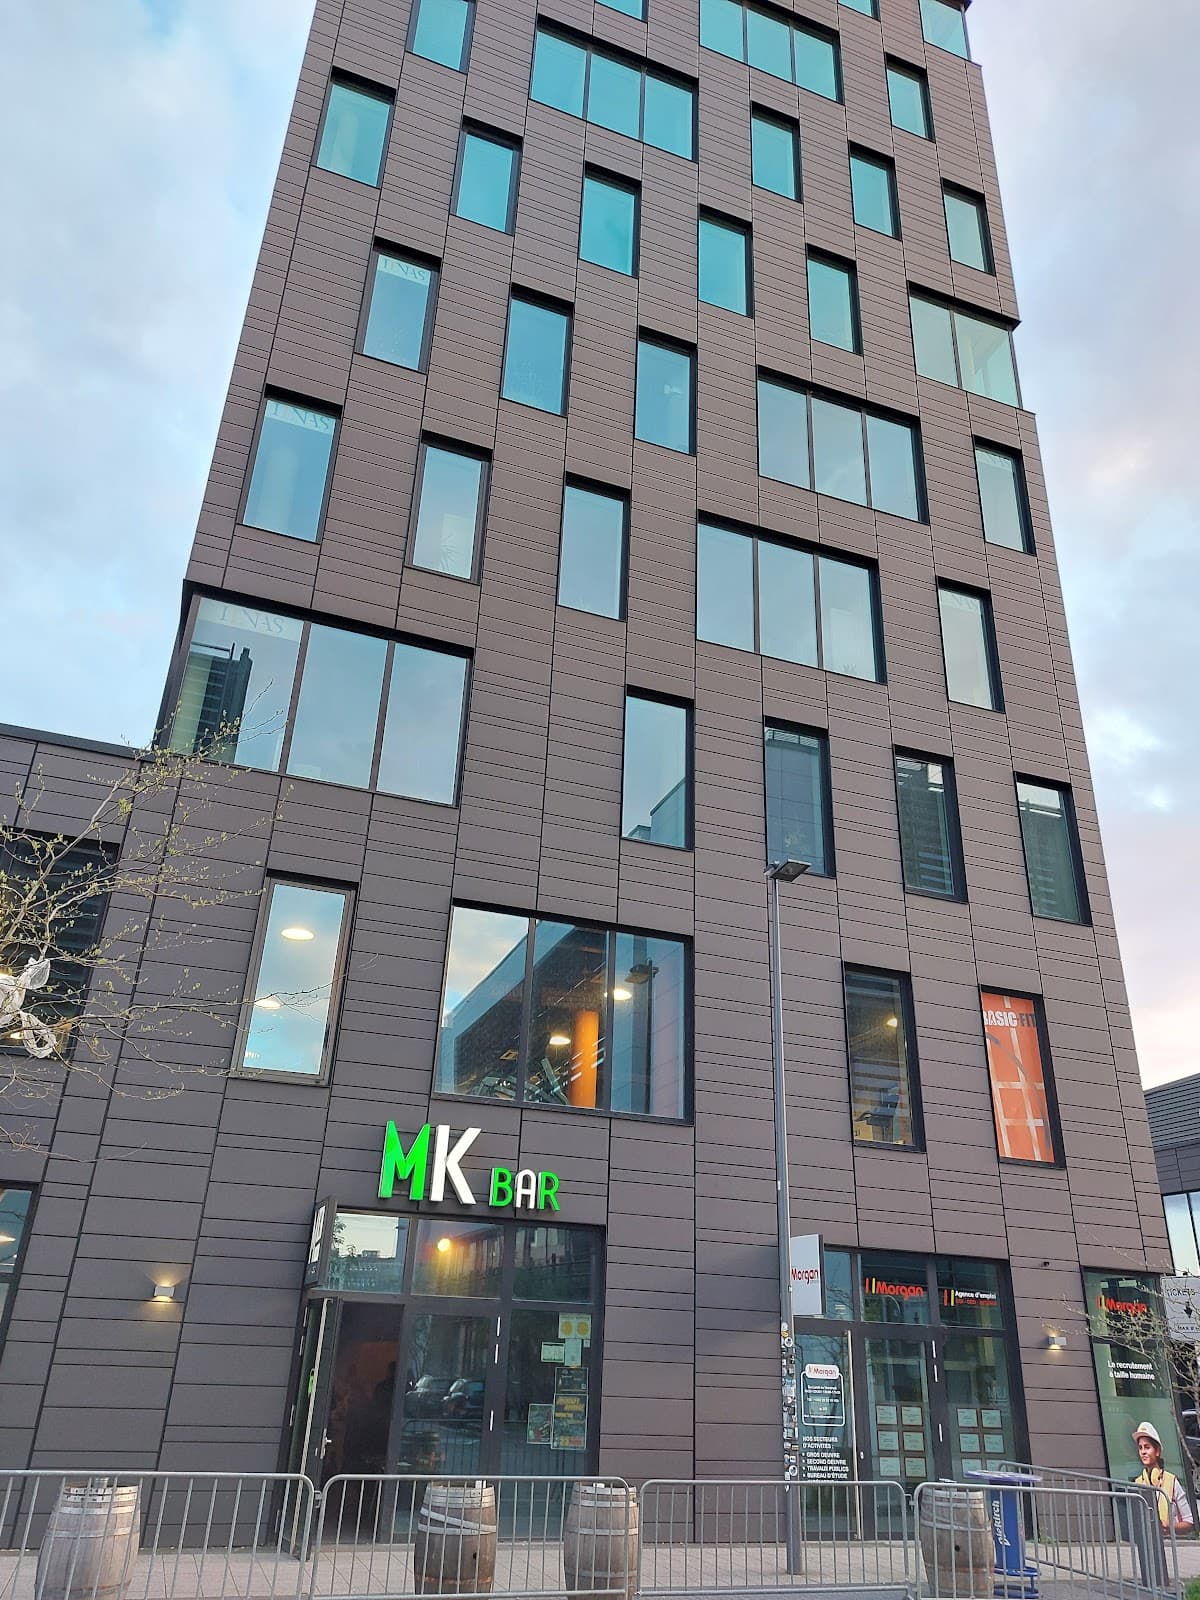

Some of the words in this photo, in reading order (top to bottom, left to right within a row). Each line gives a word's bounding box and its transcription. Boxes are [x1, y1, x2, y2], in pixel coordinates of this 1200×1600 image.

[378, 1120, 482, 1205] MK
[489, 1167, 561, 1211] BAR
[791, 1268, 819, 1285] Morgan
[876, 1280, 924, 1301] Morgan
[1106, 1297, 1147, 1316] Morgan
[813, 1367, 837, 1377] Morgan
[1116, 1361, 1153, 1370] recrutement
[1114, 1370, 1129, 1379] taille
[1129, 1371, 1156, 1380] humaine
